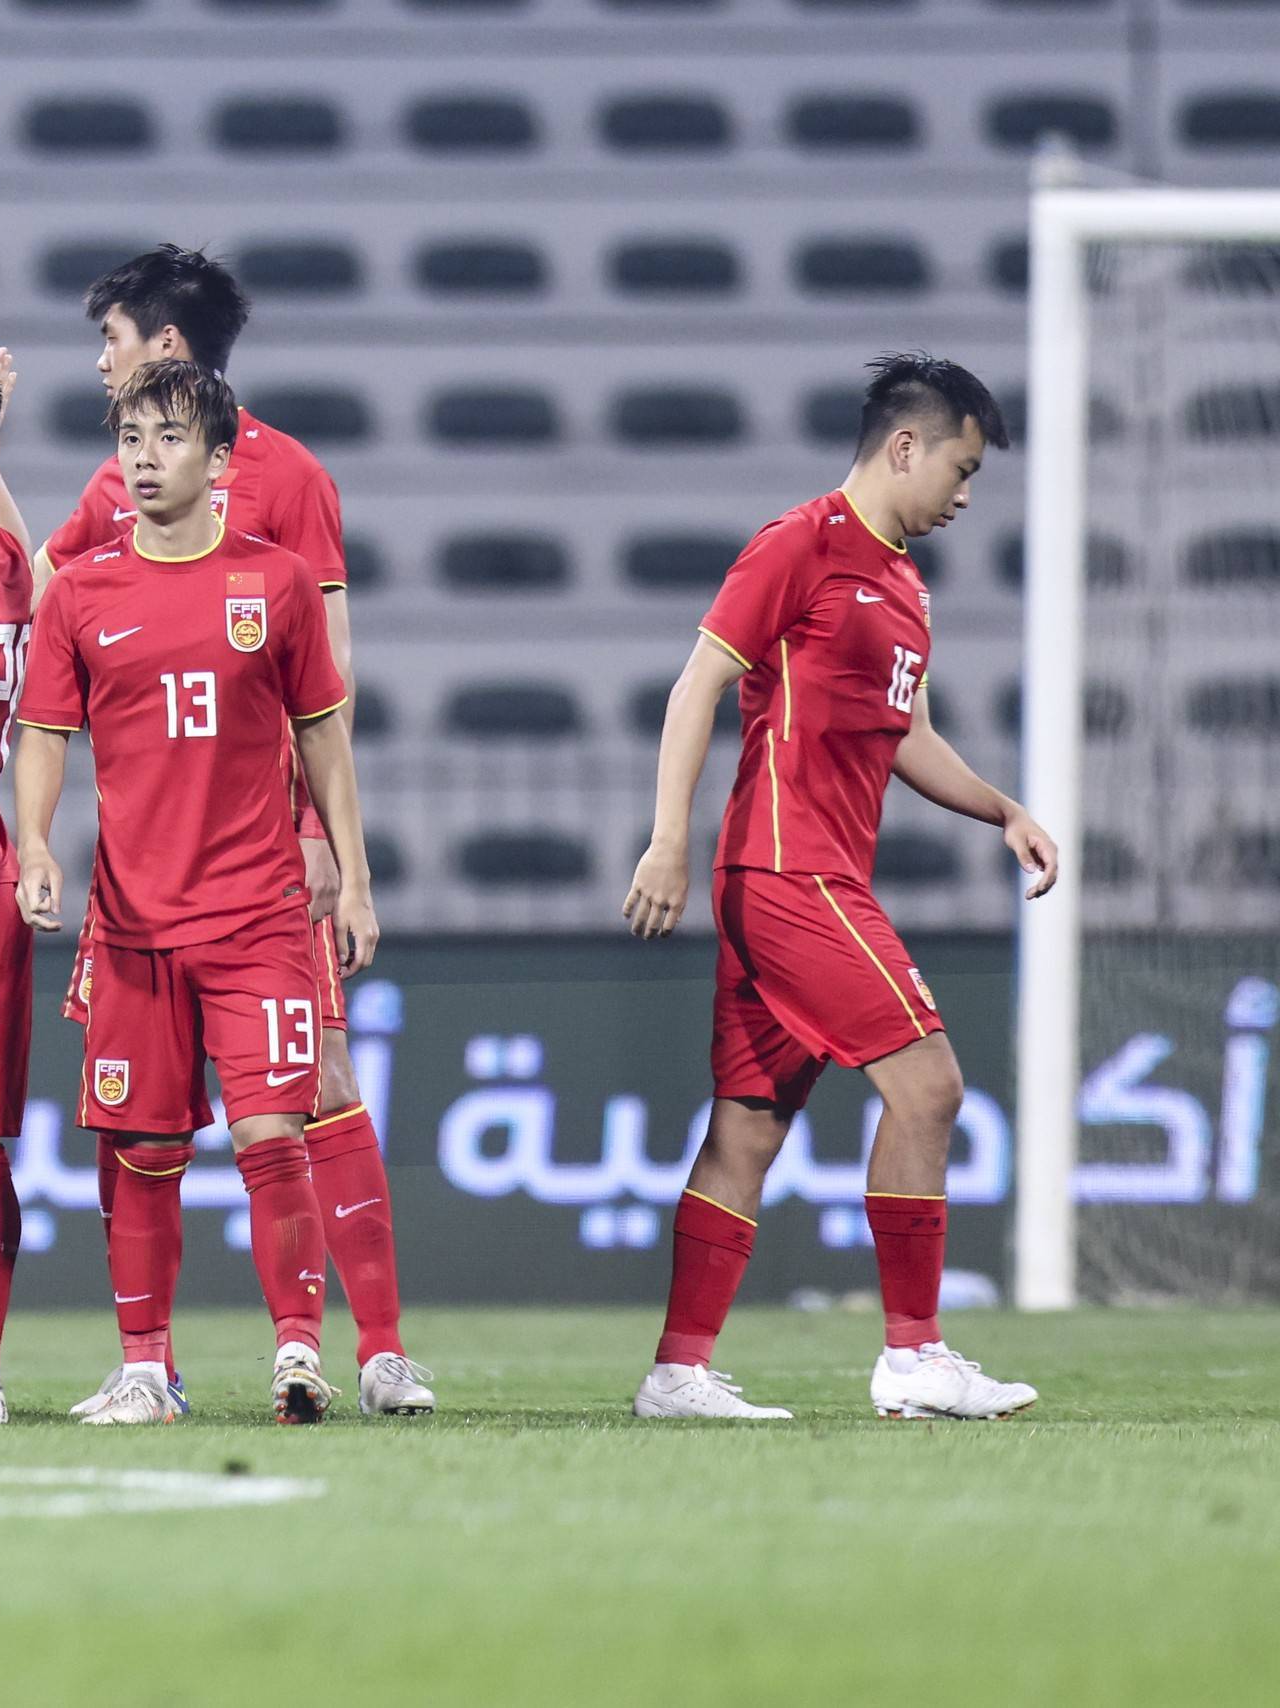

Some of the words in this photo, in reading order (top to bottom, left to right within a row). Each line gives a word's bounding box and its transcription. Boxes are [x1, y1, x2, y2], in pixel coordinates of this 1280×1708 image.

[231, 604, 261, 614] CFA
[160, 671, 218, 739] 13
[887, 645, 923, 714] 16
[261, 998, 317, 1064] 13
[100, 1065, 124, 1073] CFA
[437, 975, 1279, 1250] أكديية
